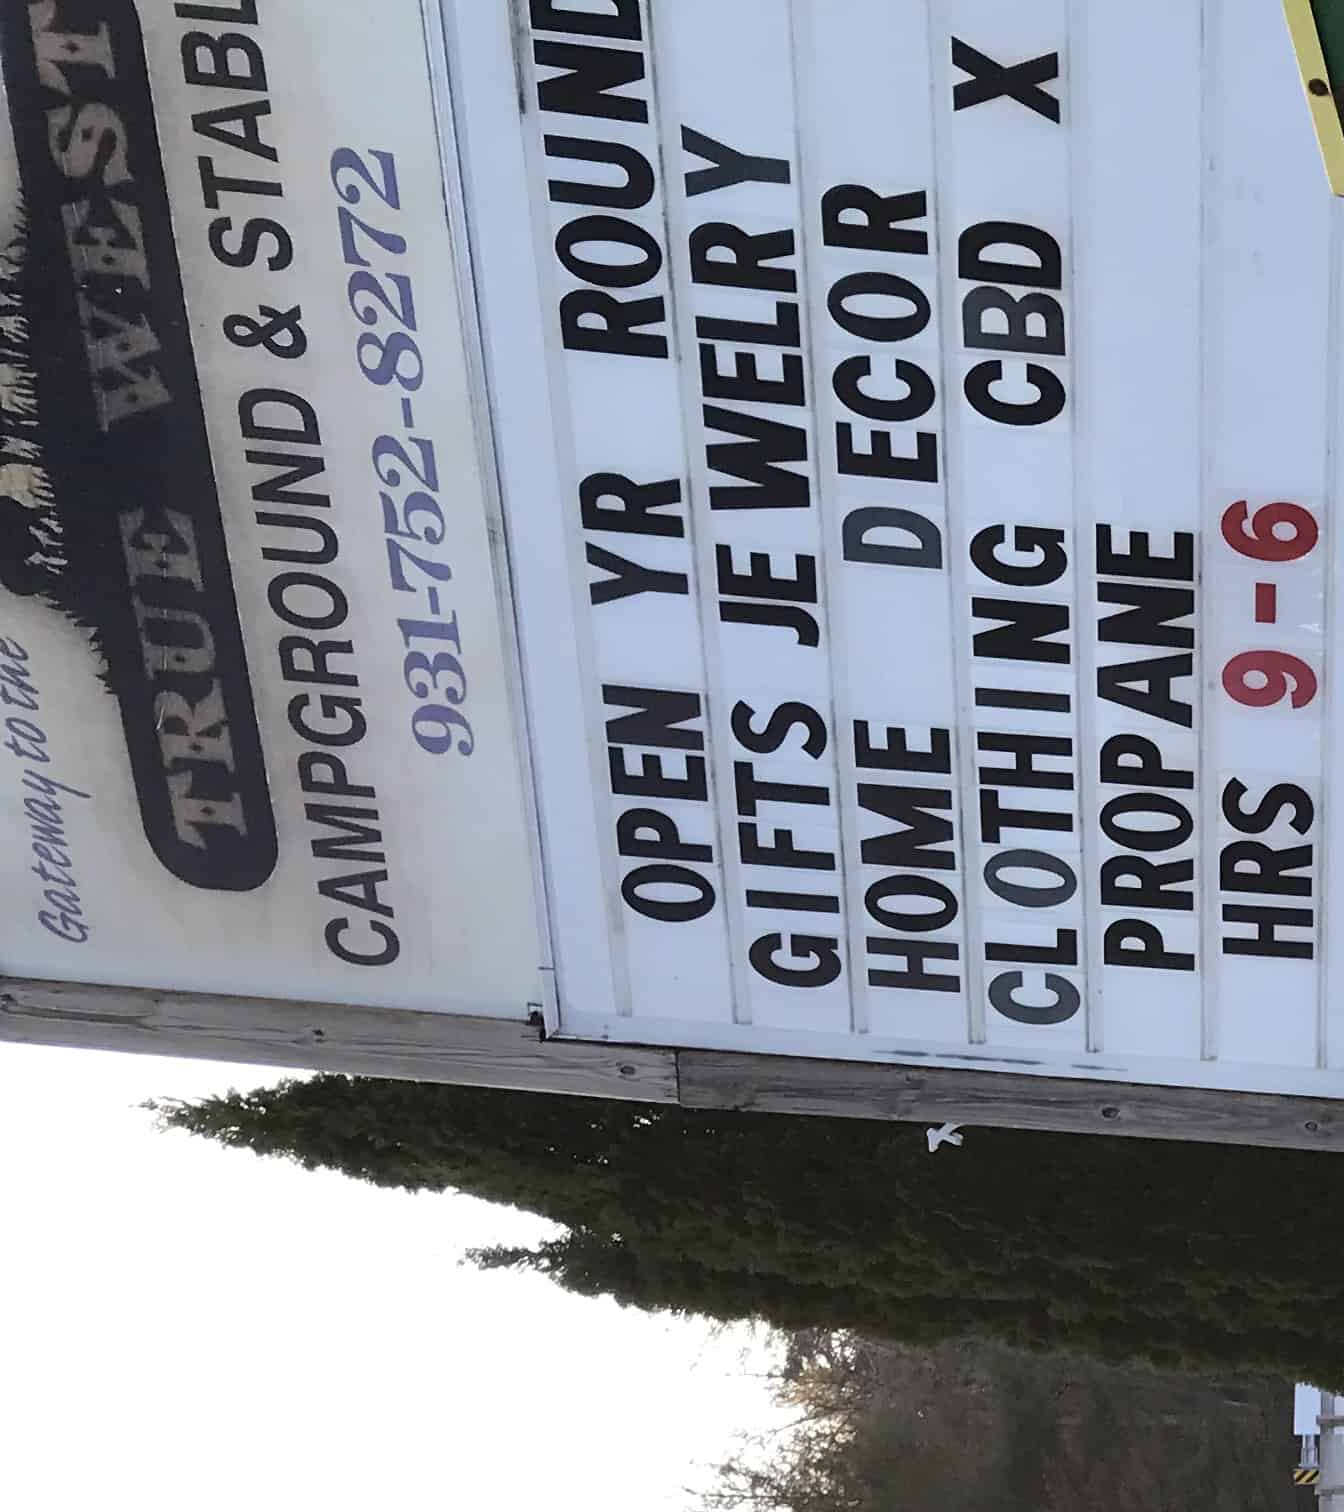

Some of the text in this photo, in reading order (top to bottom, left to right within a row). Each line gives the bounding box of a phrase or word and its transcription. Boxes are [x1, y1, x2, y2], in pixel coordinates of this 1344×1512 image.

[28, 0, 247, 849] TRUE WEST
[222, 304, 307, 359] &
[330, 147, 474, 757] 931-752-8272
[529, 0, 716, 922] OPEN YR ROUND
[821, 184, 961, 992] HOME DECOR
[951, 36, 1081, 1024] CLOTHING CBD X
[0, 636, 91, 943] Gateway to the
[238, 387, 400, 966] CAMPGROUND
[730, 700, 842, 988] GIFTS
[1096, 523, 1195, 971] PROPANE
[1219, 777, 1314, 960] HRS
